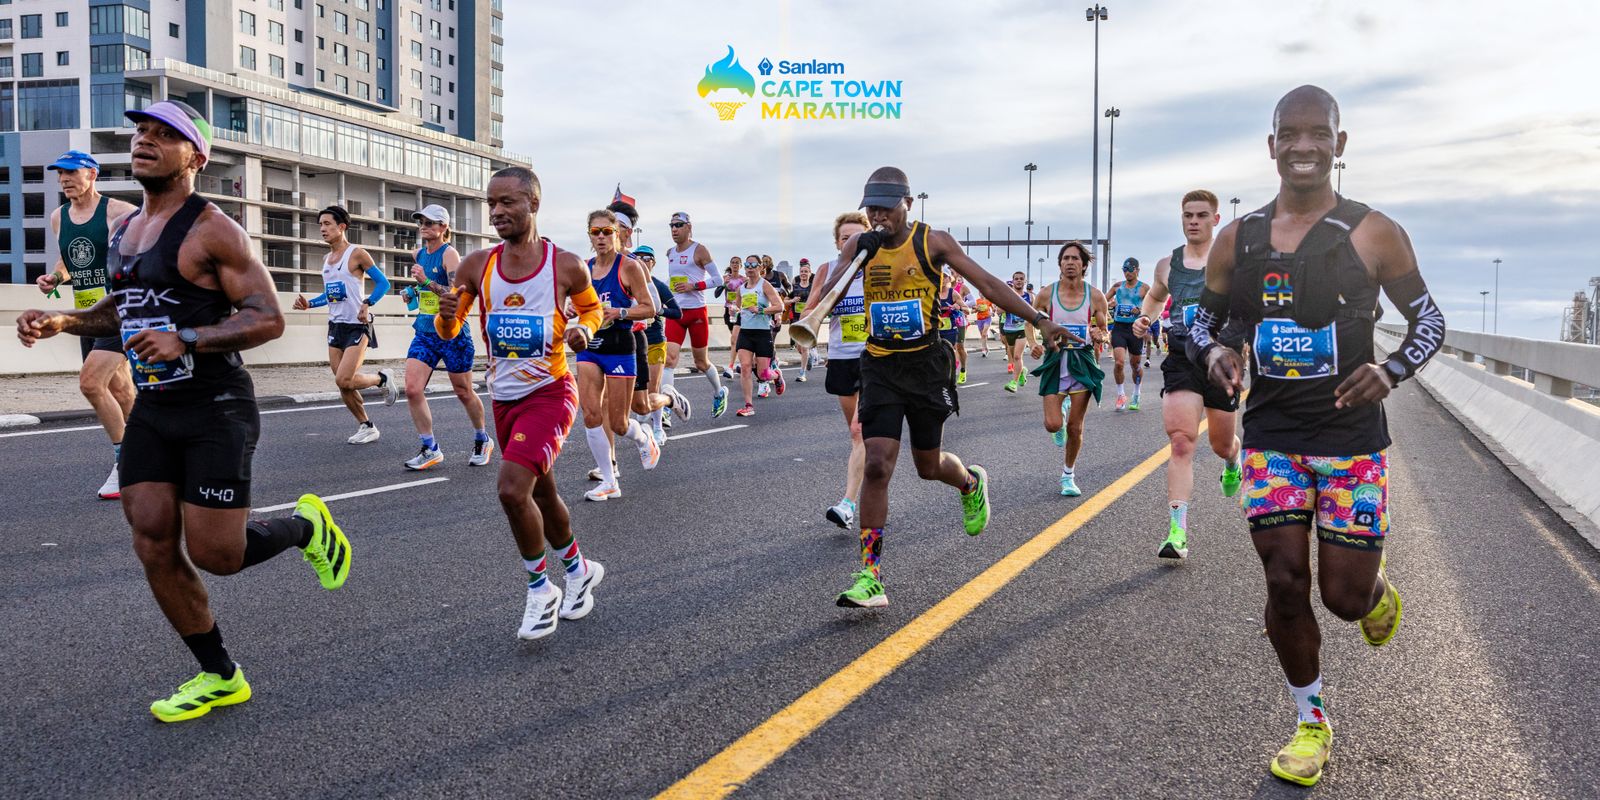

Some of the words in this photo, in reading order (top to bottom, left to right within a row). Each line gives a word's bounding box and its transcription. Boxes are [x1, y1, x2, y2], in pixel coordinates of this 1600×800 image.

[70, 269, 92, 279] RASER
[83, 276, 106, 286] CLUB
[864, 290, 902, 301] ENTURY
[903, 287, 930, 299] CITY
[505, 317, 530, 325] Sanlam
[881, 312, 910, 324] 3725
[496, 326, 532, 339] 3038
[850, 323, 866, 332] 198
[1404, 292, 1445, 366] GARMIN
[1271, 336, 1313, 352] 3212
[199, 486, 234, 502] 440
